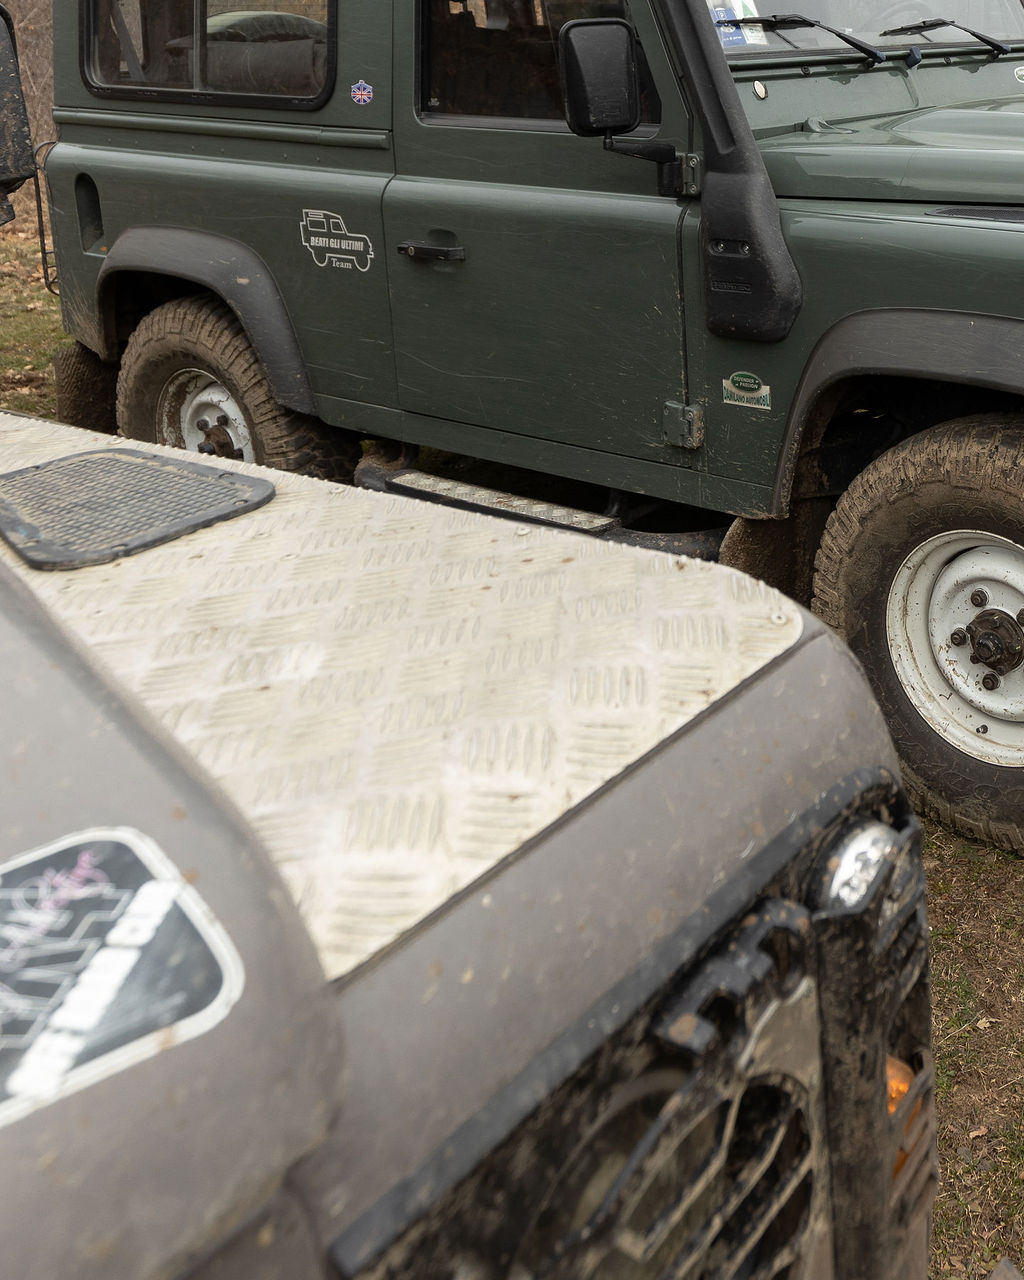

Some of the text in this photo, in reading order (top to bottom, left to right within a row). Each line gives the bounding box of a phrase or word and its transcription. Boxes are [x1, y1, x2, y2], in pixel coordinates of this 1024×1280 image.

[310, 236, 364, 251] BEATI GLI ULTIMI
[331, 258, 352, 269] Team
